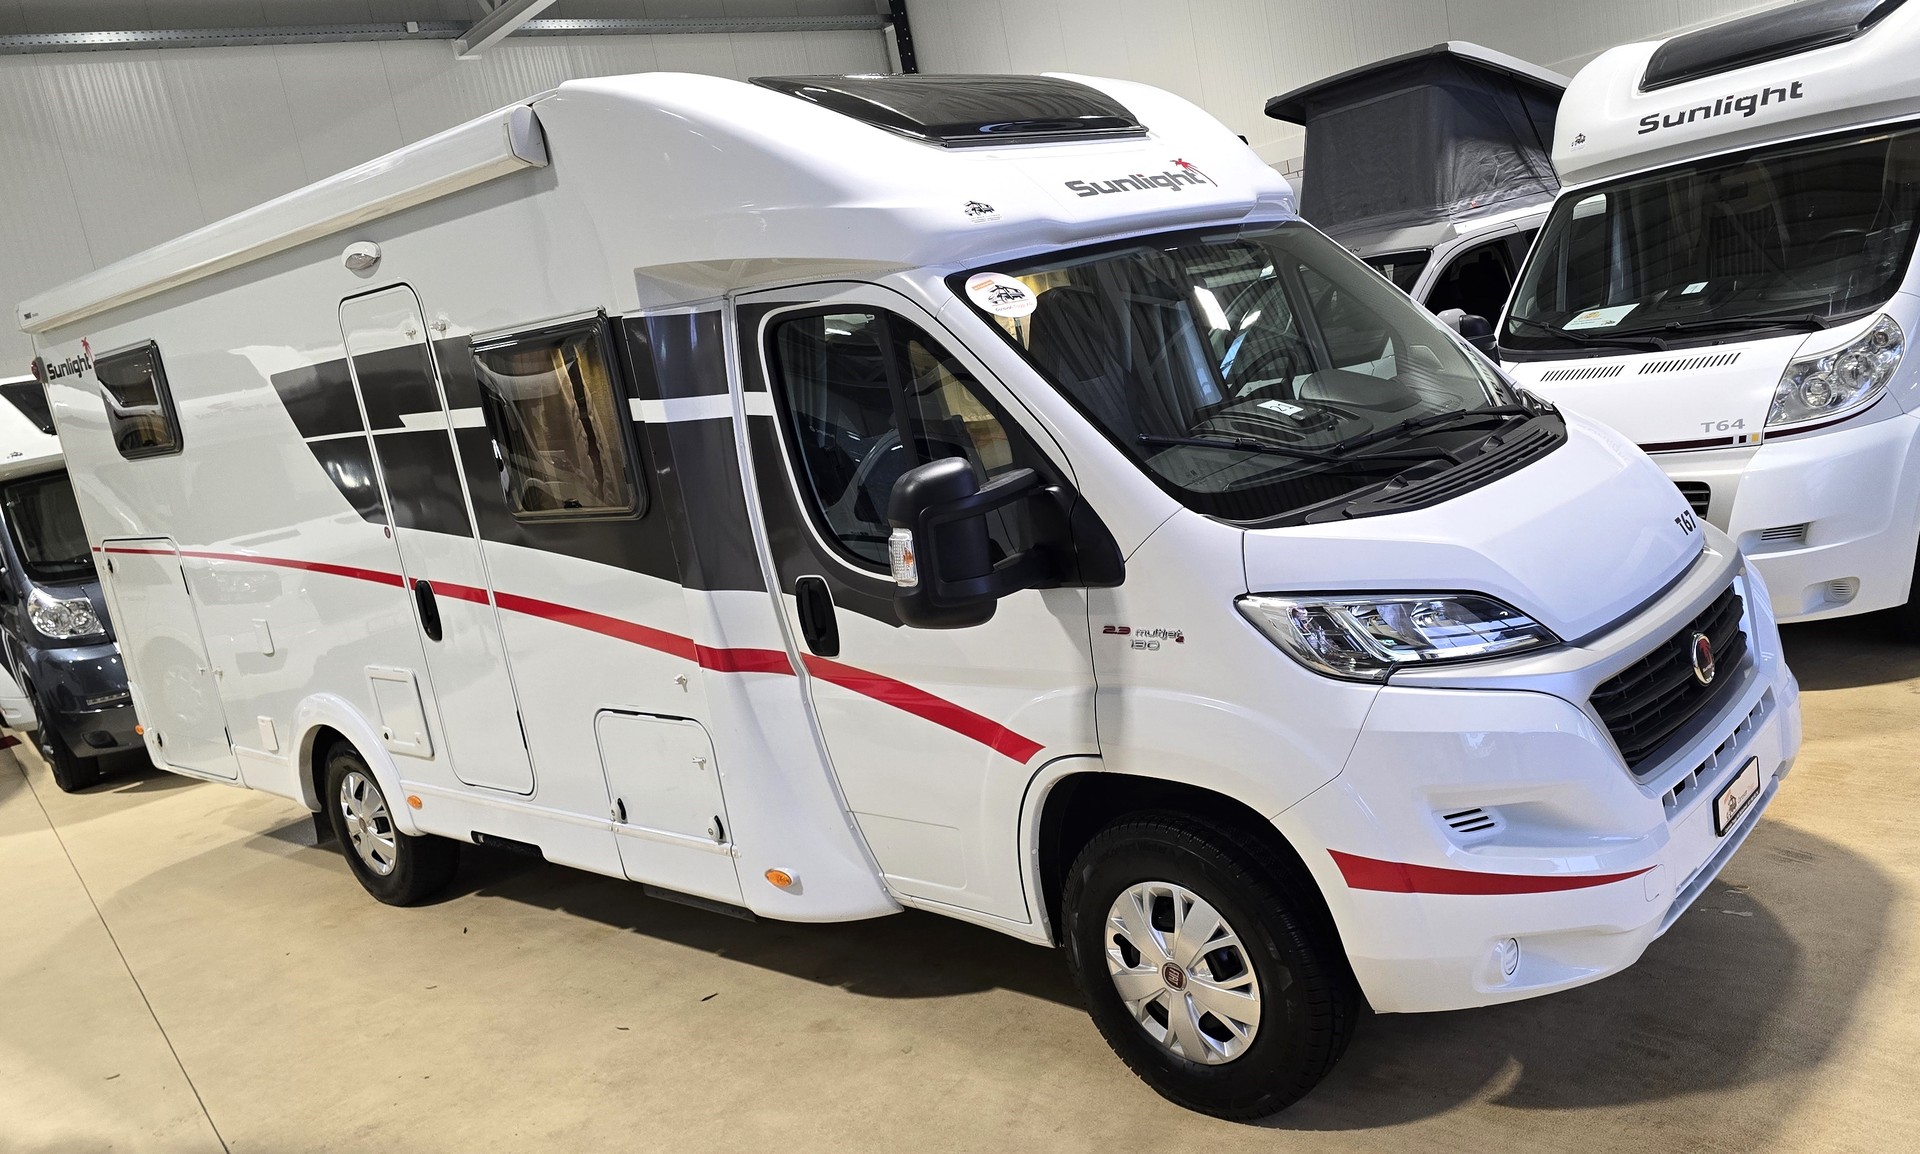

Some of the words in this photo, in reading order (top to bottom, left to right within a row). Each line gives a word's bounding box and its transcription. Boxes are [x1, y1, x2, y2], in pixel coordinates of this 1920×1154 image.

[1638, 80, 1803, 135] Sunlight
[1065, 170, 1207, 197] Sunlight
[46, 353, 92, 380] Sunlight
[1700, 418, 1746, 433] T64
[1674, 509, 1697, 536] T67
[1102, 625, 1131, 635] 2.3
[1167, 967, 1180, 986] FIAT
